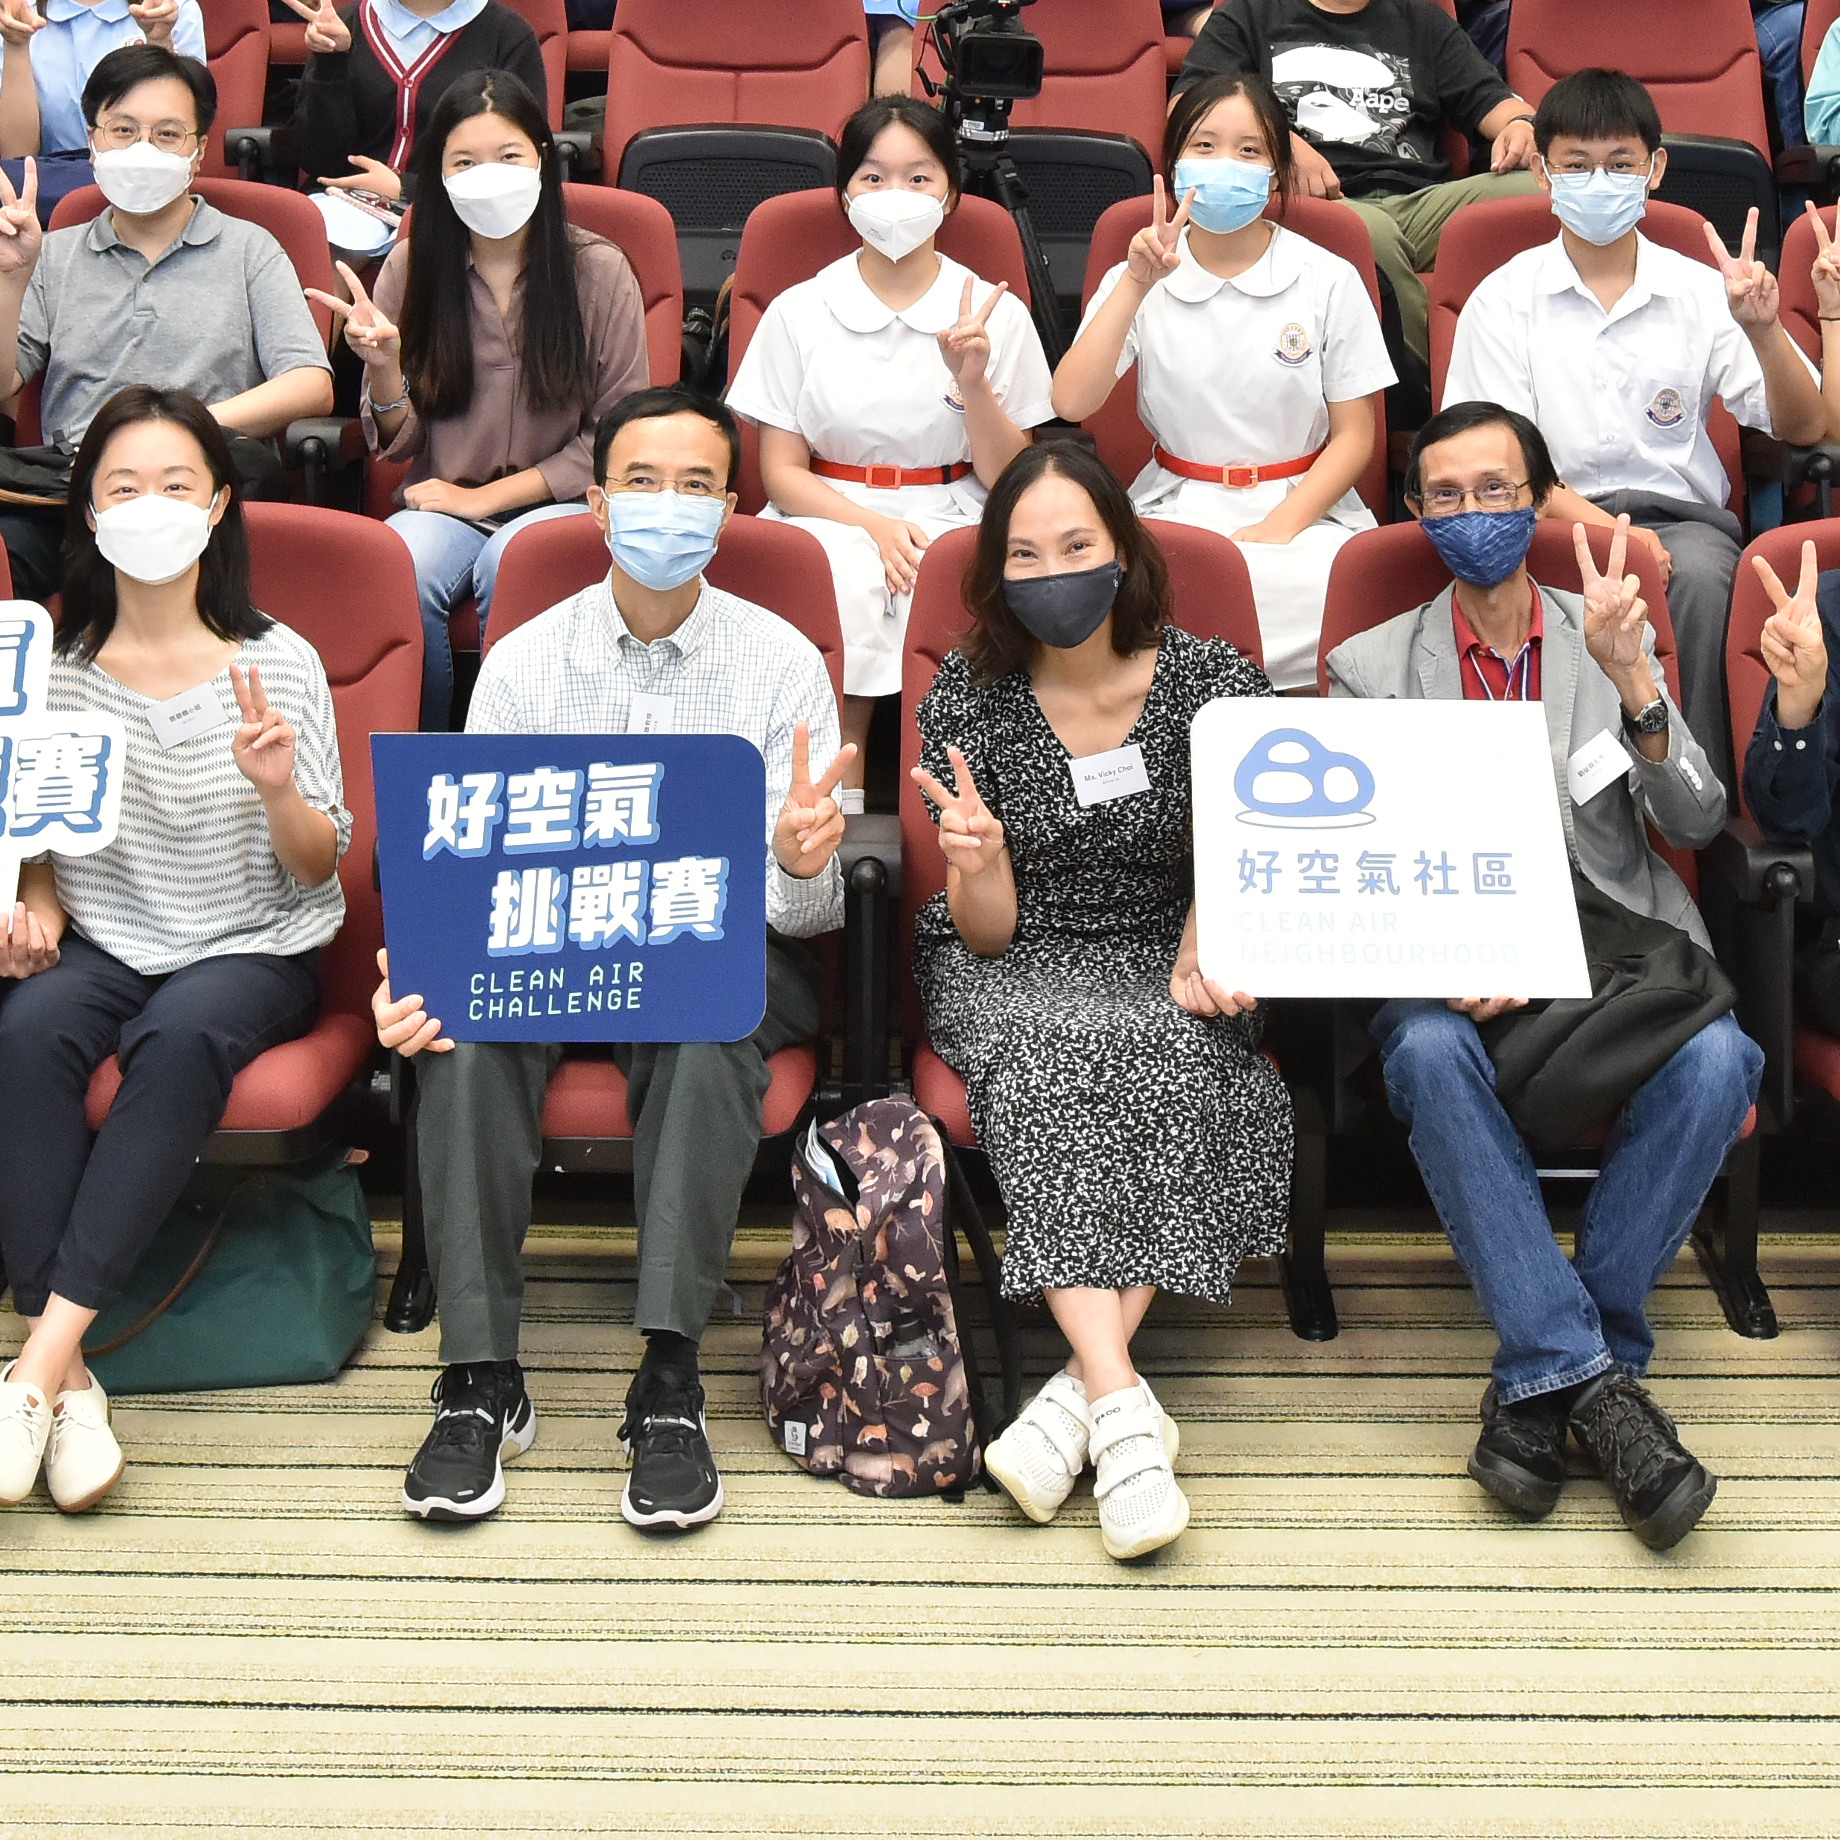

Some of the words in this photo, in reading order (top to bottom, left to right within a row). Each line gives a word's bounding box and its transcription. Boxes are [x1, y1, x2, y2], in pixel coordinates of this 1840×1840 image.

[1349, 89, 1410, 113] Aape
[1098, 768, 1116, 778] Vicky
[423, 762, 665, 860] 好空氣
[1237, 848, 1517, 896] 好空氣社區
[487, 856, 730, 957] 挑戰賽
[1239, 911, 1336, 932] CLEAN
[1350, 911, 1398, 932] AIR
[1240, 942, 1519, 964] NEIGHBOURHOOD
[470, 967, 564, 995] CLEAN
[589, 962, 644, 985] AIR
[469, 988, 642, 1021] CHALLENGE
